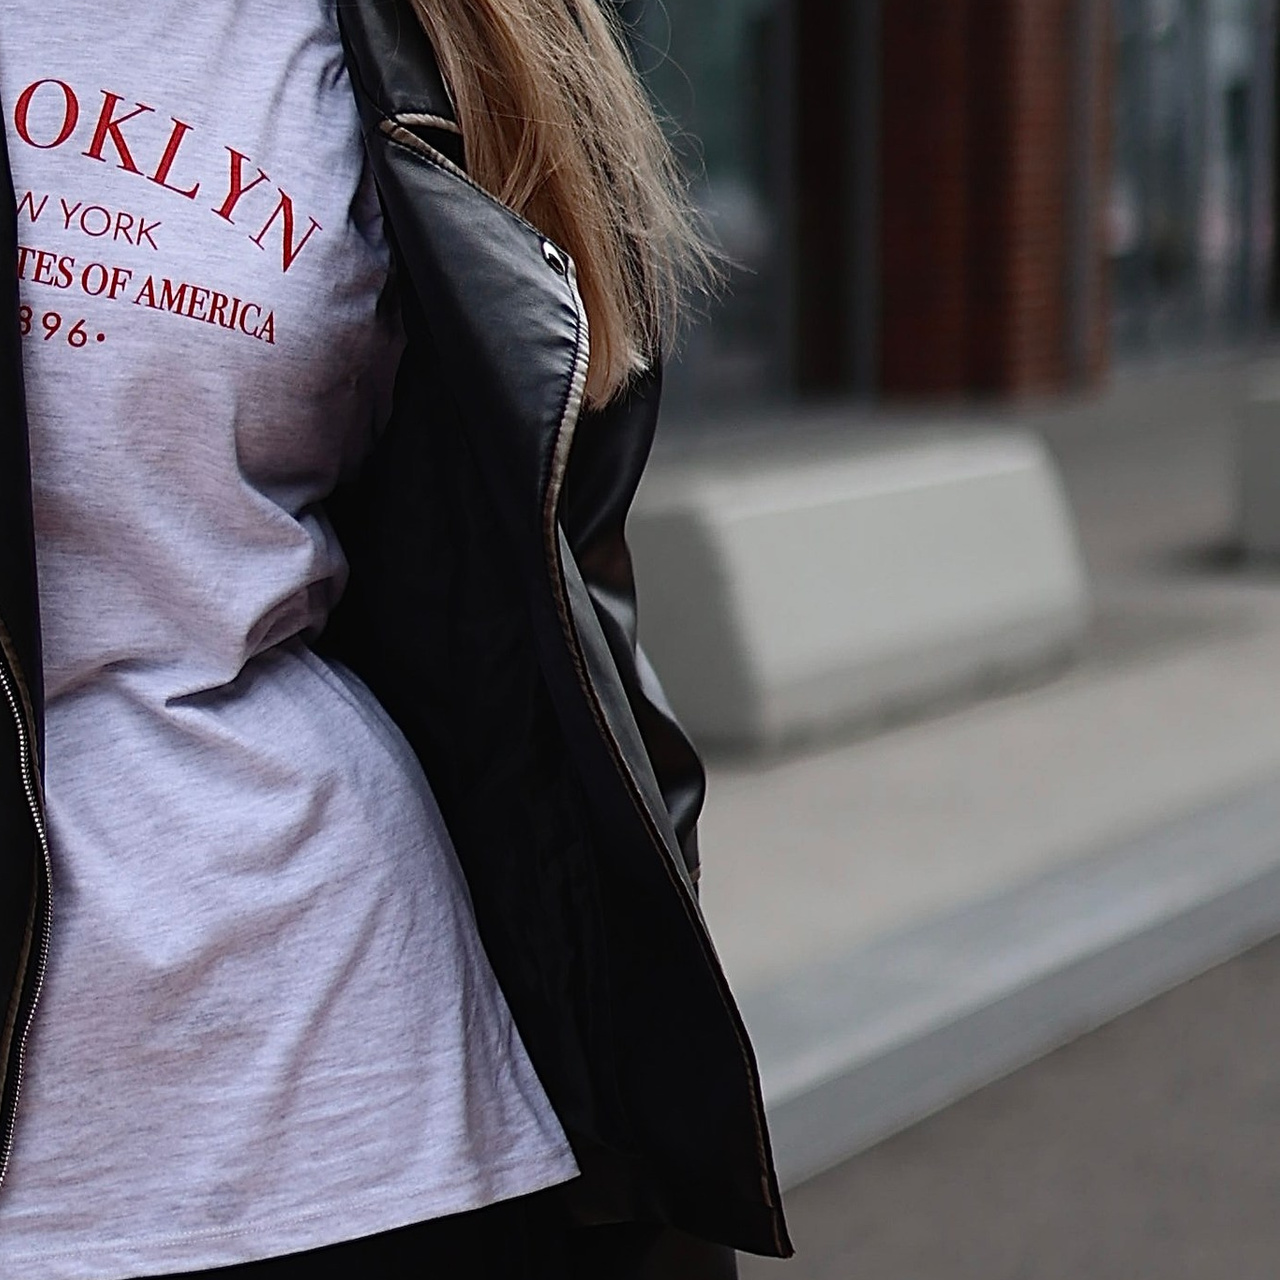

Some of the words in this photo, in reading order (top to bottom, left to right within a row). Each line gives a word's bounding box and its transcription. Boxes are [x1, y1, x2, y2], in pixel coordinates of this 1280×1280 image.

[14, 78, 323, 273] OKLYN
[60, 197, 162, 251] YORK
[18, 246, 75, 289] TES
[81, 263, 132, 300] OF
[132, 274, 276, 345] AMERICA
